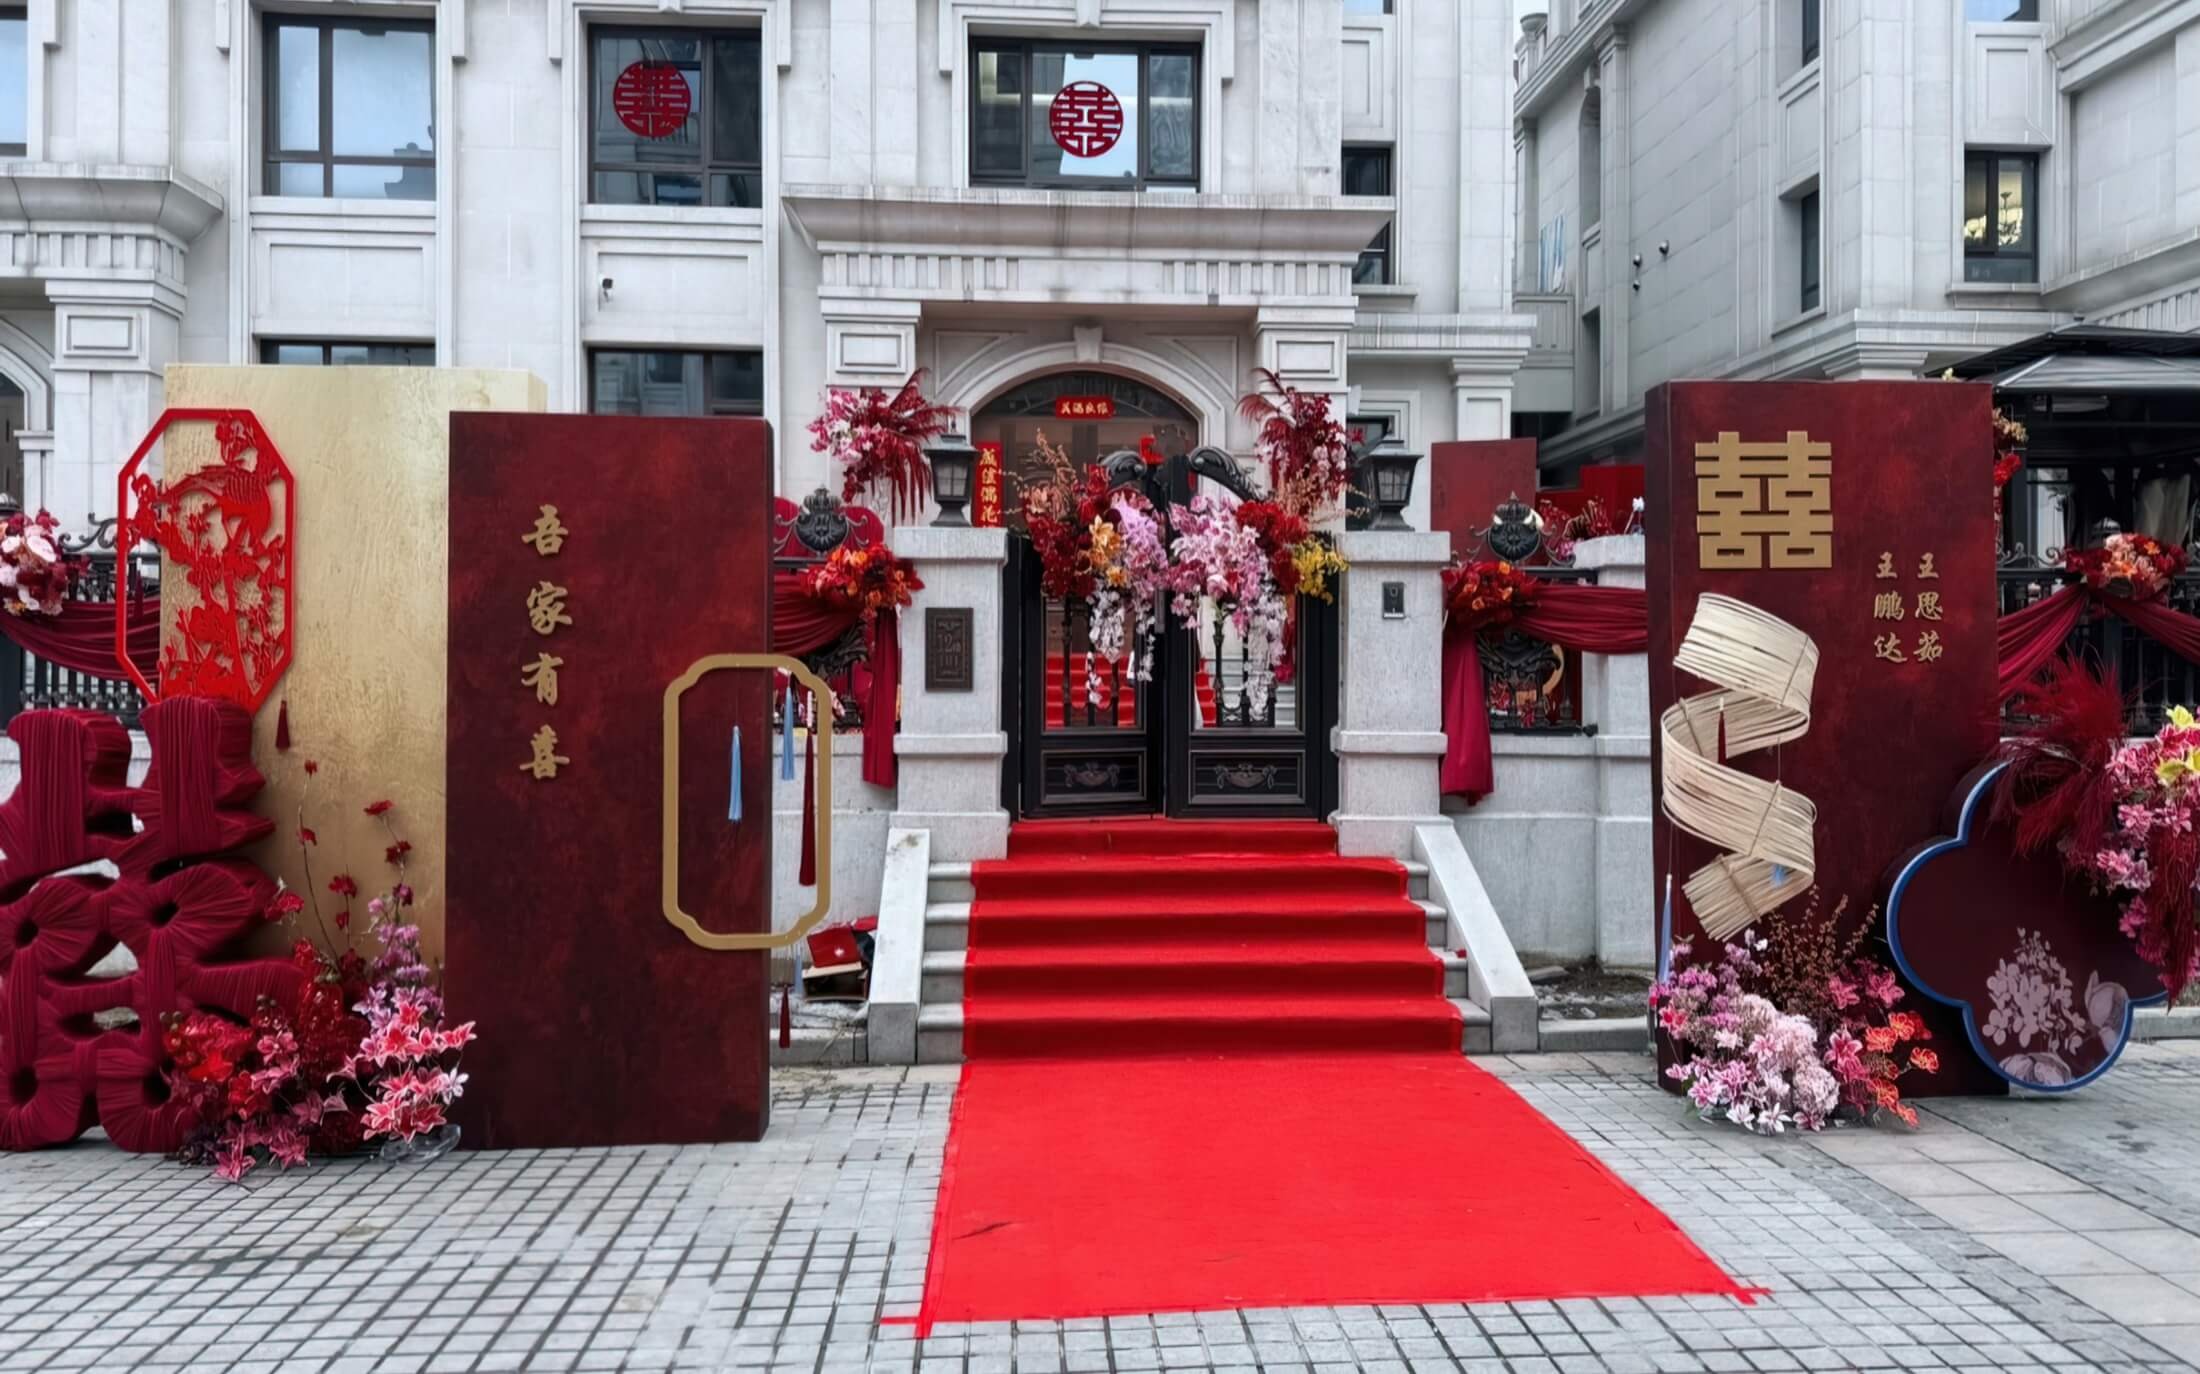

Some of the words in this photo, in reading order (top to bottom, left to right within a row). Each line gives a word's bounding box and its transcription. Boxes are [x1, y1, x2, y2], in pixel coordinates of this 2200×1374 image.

[1695, 431, 1833, 568] 囍
[520, 504, 573, 779] 吾家有喜
